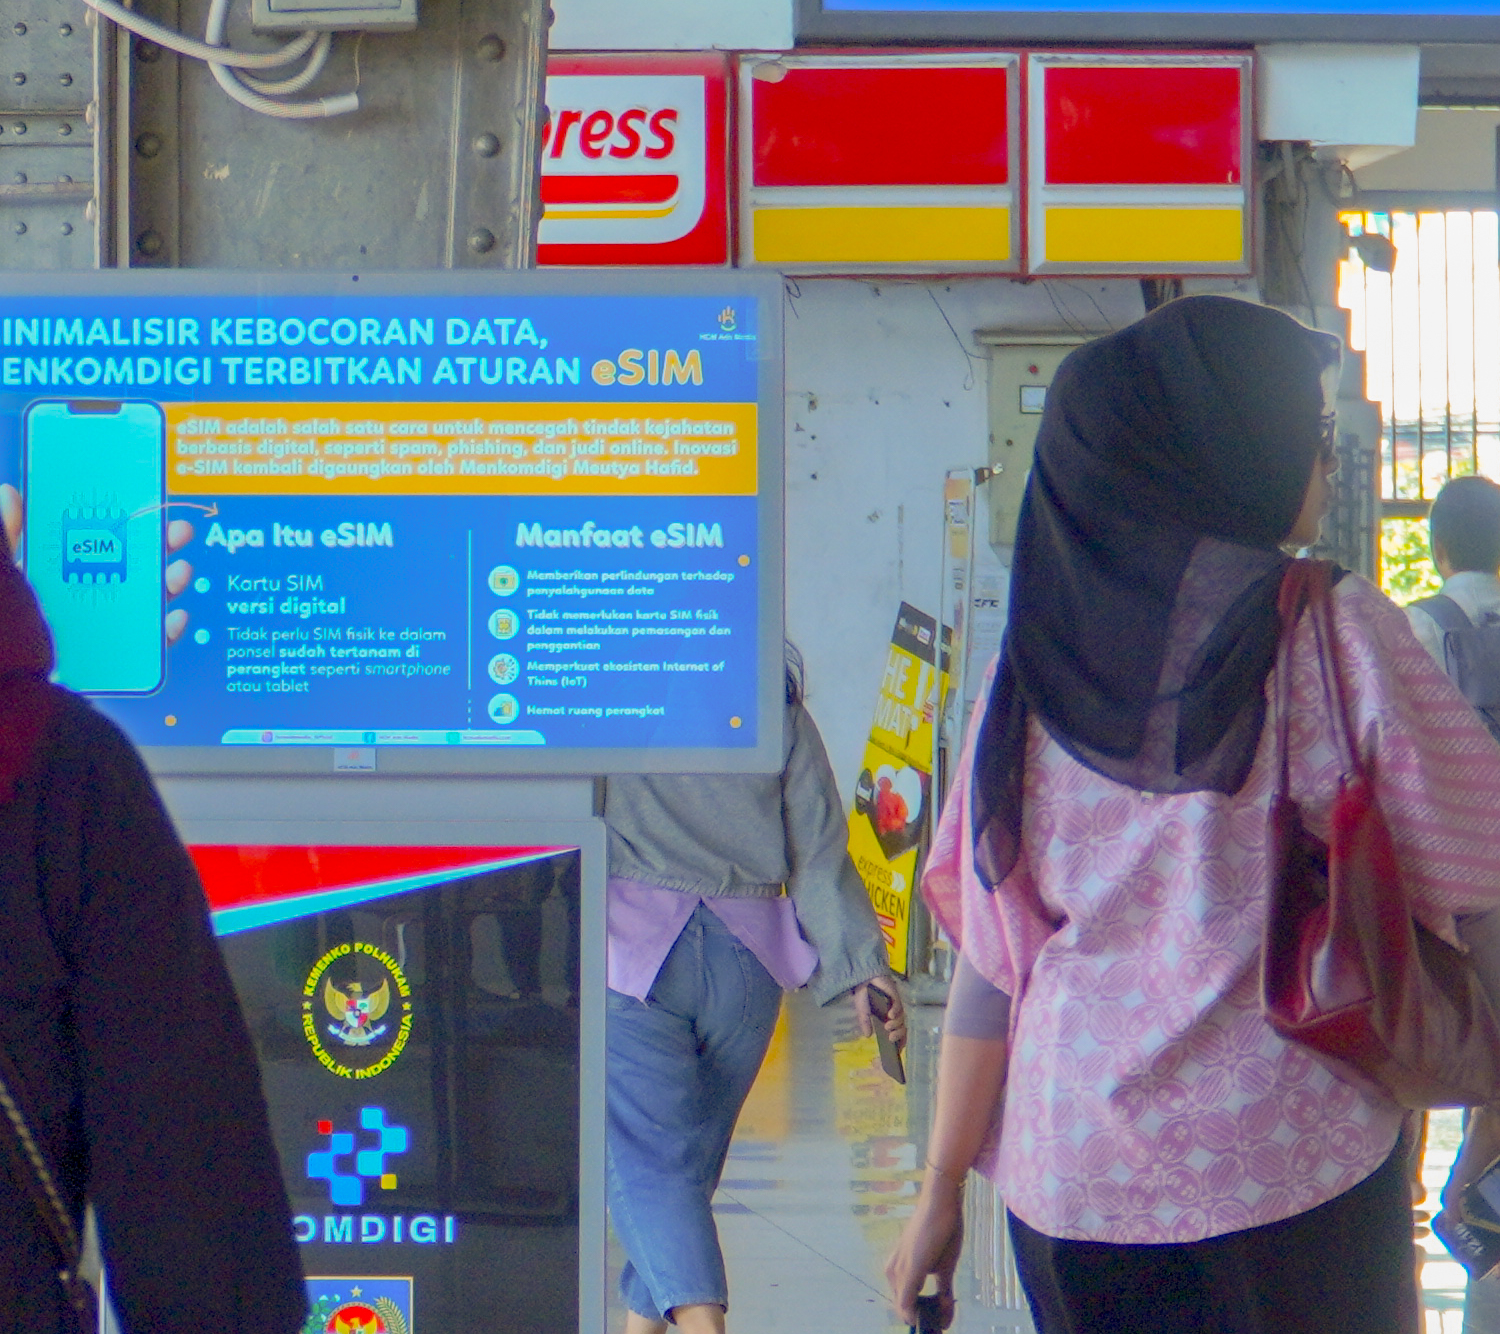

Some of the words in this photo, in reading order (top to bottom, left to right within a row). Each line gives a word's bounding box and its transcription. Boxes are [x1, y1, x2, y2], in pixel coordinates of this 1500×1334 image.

[211, 318, 433, 346] KEBOCORAN
[446, 318, 548, 349] DATA,
[222, 357, 421, 386] TERBITKAN
[433, 357, 580, 386] ATURAN
[592, 349, 703, 386] eSIM
[176, 420, 220, 435] eSIM
[226, 420, 287, 435] adalah
[292, 420, 341, 435] salah
[346, 420, 384, 435] satu
[389, 423, 428, 435] cara
[433, 420, 483, 435] untuk
[489, 420, 578, 439] mencegah
[583, 420, 640, 435] tindak
[645, 420, 734, 438] kejahatan
[177, 440, 252, 456] berbasis
[256, 440, 319, 459] digital,
[324, 440, 384, 458] seperti
[389, 443, 442, 459] spam,
[447, 440, 528, 459] phishing,
[532, 440, 567, 456] dan
[570, 440, 605, 458] judi
[610, 440, 668, 456] online.
[674, 440, 737, 456] Inovasi
[176, 460, 227, 475] e-SIM
[233, 460, 302, 475] kembali
[307, 460, 413, 479] digaungkan
[417, 460, 454, 475] oleh
[459, 460, 568, 480] Menkomdigi
[573, 460, 640, 479] Meutya
[646, 460, 699, 475] Hafid.
[205, 522, 265, 554] Apa
[273, 521, 313, 547] Itu
[320, 521, 394, 547] eSIM
[515, 521, 645, 548] Manfaat
[650, 521, 724, 548] eSIM
[72, 539, 114, 553] eSIM
[227, 574, 281, 592] Kartu
[286, 574, 324, 592] SIM
[527, 570, 598, 581] Memberikan
[601, 570, 679, 583] perlindungan
[681, 570, 735, 583] terhadap
[226, 596, 274, 614] versi
[279, 596, 346, 619] digital
[227, 627, 268, 641] Tidak
[271, 627, 309, 644] perlu
[313, 627, 341, 641] SIM
[345, 627, 375, 641] fisik
[379, 627, 396, 641] ke
[399, 627, 446, 641] dalam
[227, 644, 275, 661] ponsel
[279, 644, 326, 659] sudah
[330, 644, 401, 659] tertanam
[405, 644, 420, 659] di
[227, 662, 306, 678] perangkat
[310, 662, 360, 678] seperti
[364, 662, 451, 678] smartphone
[226, 680, 262, 693] atau
[265, 680, 310, 693] tablet
[857, 855, 893, 887] express
[303, 943, 351, 997] KEMENKO
[302, 1014, 353, 1079] REPUBLIK
[355, 1014, 413, 1079] INDONESIA
[292, 1215, 455, 1244] OMDIGI
